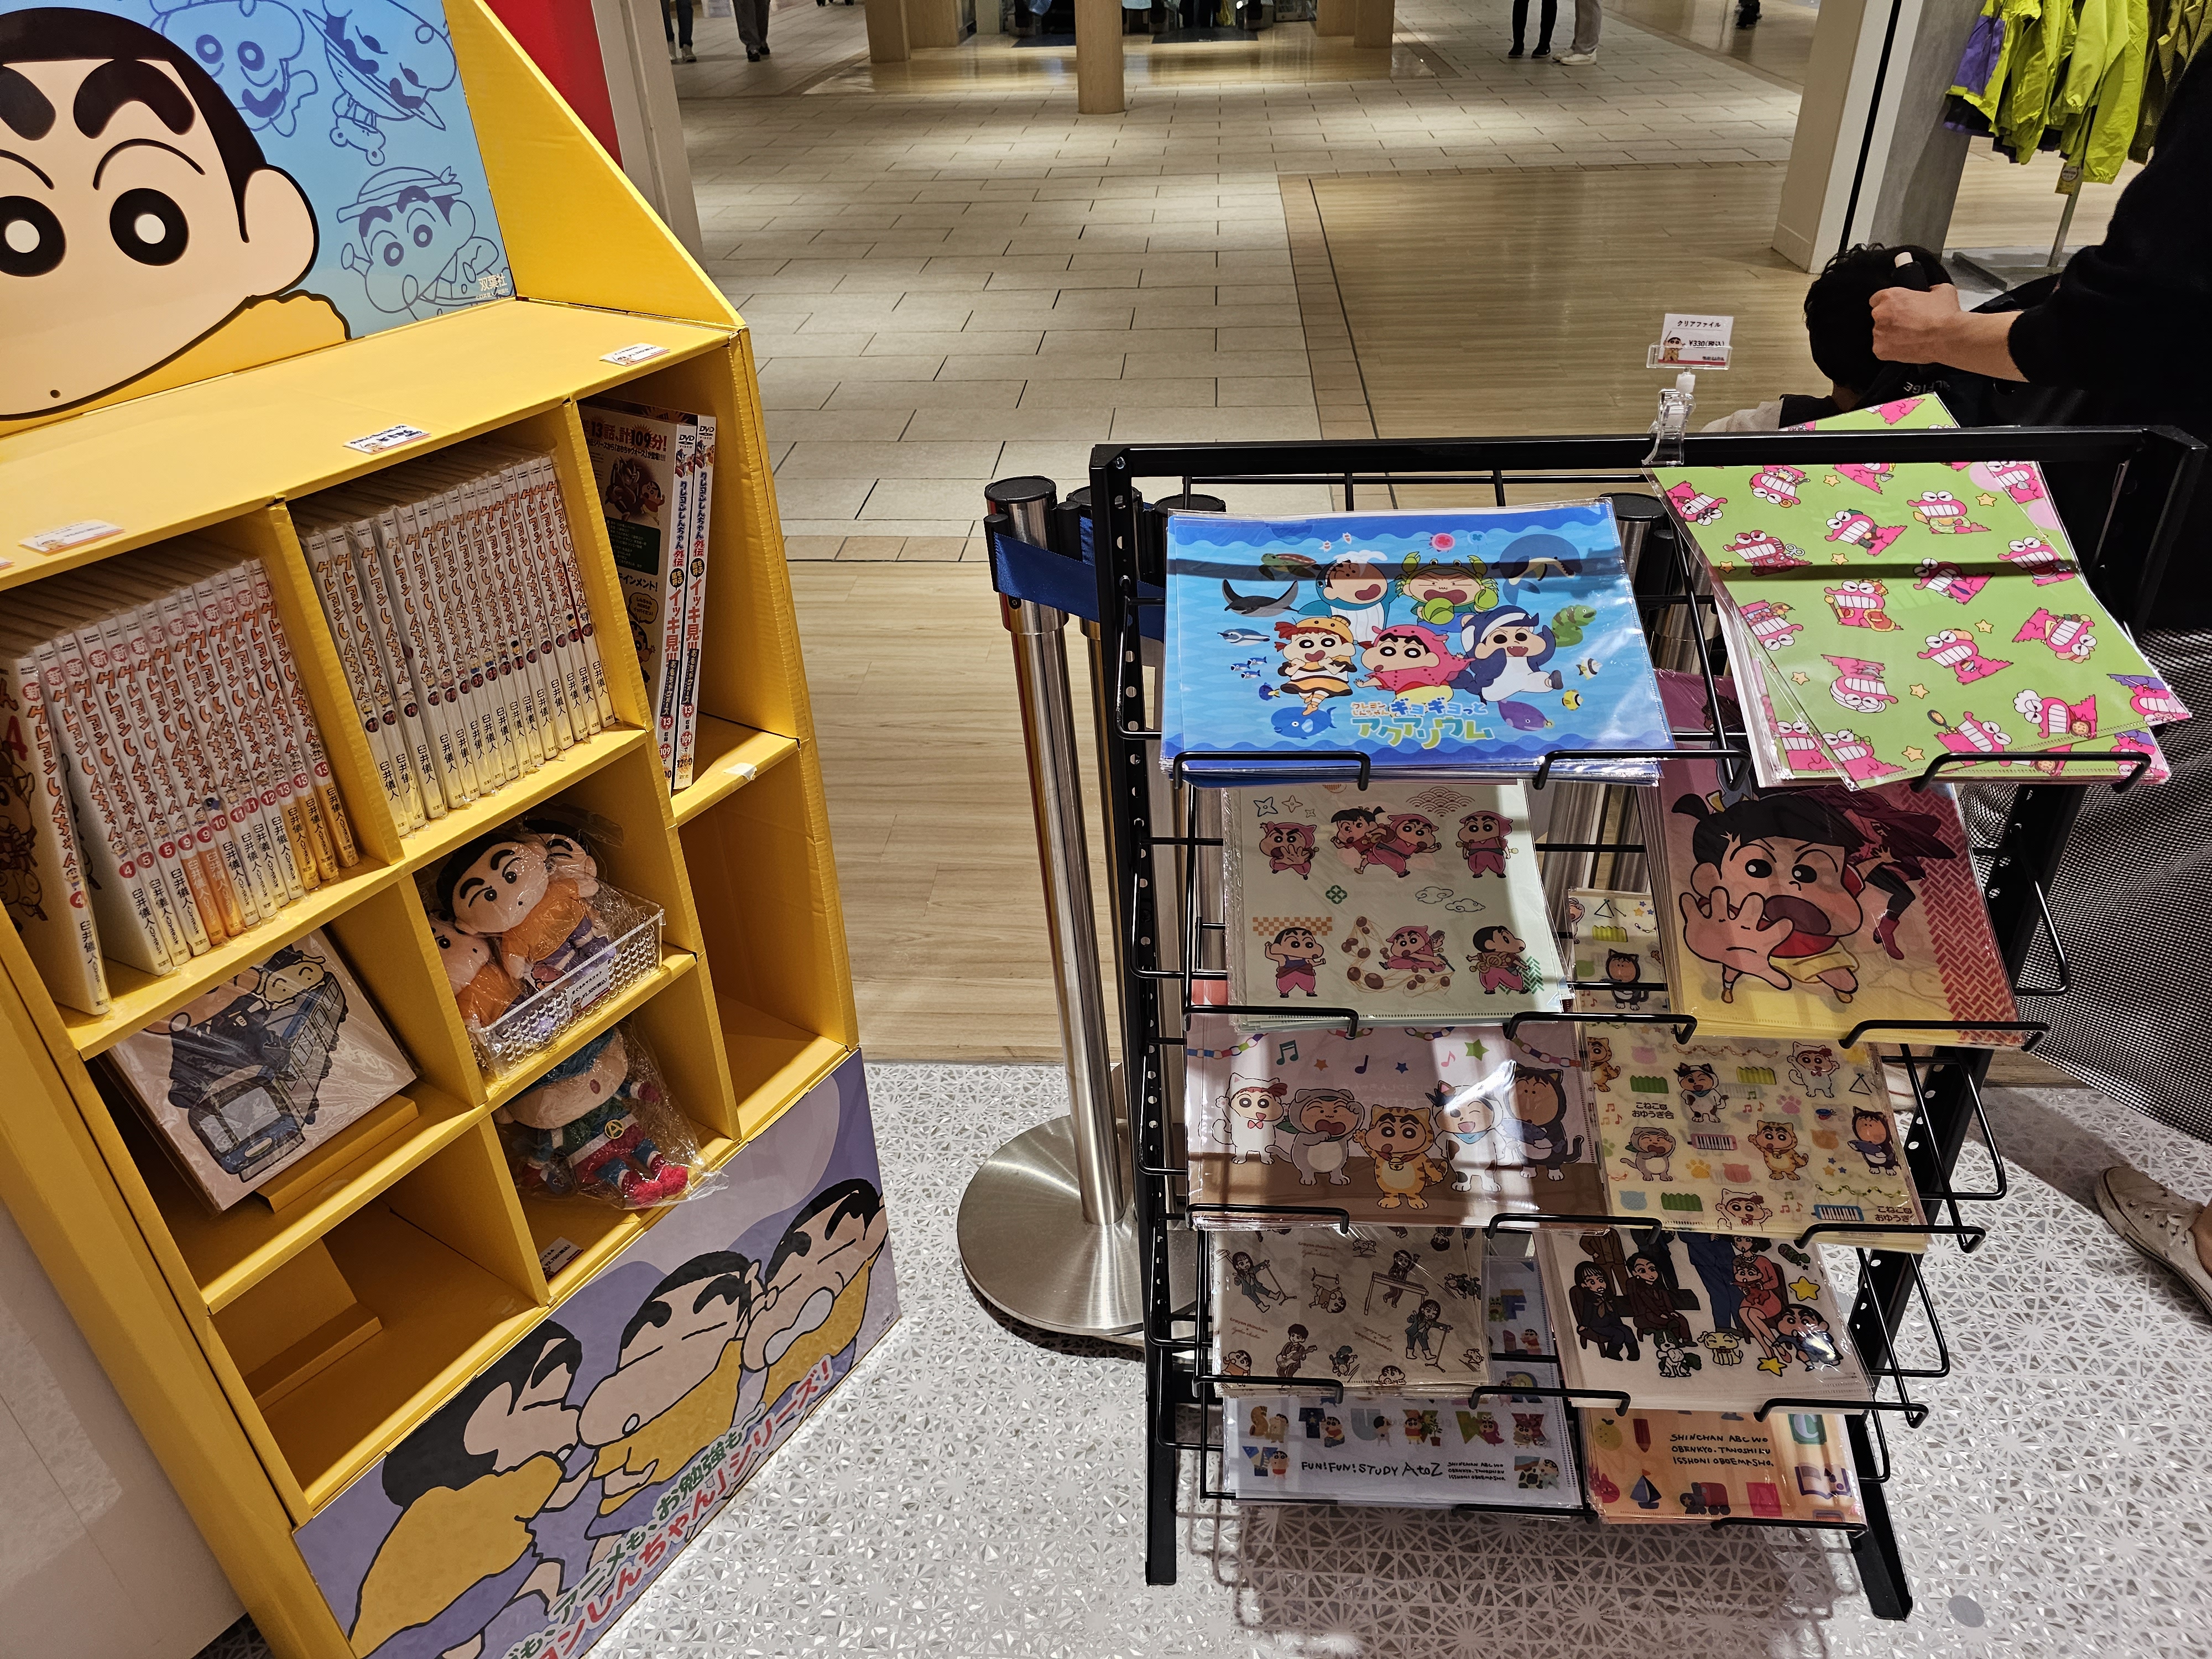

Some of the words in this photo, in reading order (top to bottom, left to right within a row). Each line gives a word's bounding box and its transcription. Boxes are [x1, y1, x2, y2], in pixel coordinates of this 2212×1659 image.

[478, 273, 507, 291] 双葉社
[673, 550, 685, 567] 外伝
[675, 481, 687, 549] クレヨンしんちゃん
[693, 539, 705, 556] 外伝
[695, 471, 707, 540] クレヨンしんちゃん
[91, 651, 107, 667] 新
[387, 537, 432, 674] クレヨンしんちゃん
[440, 734, 457, 774] 臼井儀人
[406, 533, 448, 669] クレヨンしんちゃん
[456, 728, 472, 768] 臼井儀人
[422, 526, 463, 660] クレヨンしんちゃん
[471, 721, 484, 759] 臼井儀人
[437, 520, 476, 655] クレヨンしんちゃん
[482, 714, 497, 752] 臼井儀人
[451, 514, 491, 648] クレヨンしんちゃん
[497, 707, 511, 745] 臼井儀人
[467, 510, 504, 643] クレヨンしんちゃん
[510, 701, 524, 739] 臼井儀人
[481, 505, 518, 637] クレヨンしんちゃん
[523, 696, 537, 734] 臼井儀人
[494, 501, 531, 630] クレヨンしんちゃん
[537, 688, 551, 727] 臼井儀人
[507, 493, 545, 623] クレヨンしんちゃん
[551, 679, 566, 717] 臼井儀人
[520, 487, 560, 617] クレヨンしんちゃん
[566, 672, 581, 709] 臼井儀人
[533, 484, 572, 611] クレヨンしんちゃん
[579, 666, 593, 704] 臼井儀人
[546, 480, 586, 606] クレヨンしんちゃん
[592, 661, 608, 697] 臼井儀人
[25, 684, 41, 701] 新
[46, 668, 63, 685] 新
[67, 660, 84, 676] 新
[118, 664, 182, 815] クレヨンしんちゃん
[139, 658, 201, 807] クレヨンしんちゃん
[154, 646, 216, 795] クレヨンしんちゃん
[175, 638, 234, 787] クレヨンしんちゃん
[190, 630, 248, 776] クレヨンしんちゃん
[210, 624, 266, 770] クレヨンしんちゃん
[227, 617, 281, 762] クレヨンしんちゃん
[243, 609, 298, 753] クレヨンしんちゃん
[262, 602, 318, 743] クレヨンしんちゃん
[316, 560, 369, 700] クレヨンしんちゃん
[380, 761, 399, 801] 臼井儀人
[336, 553, 387, 693] クレヨンしんちゃん
[396, 754, 415, 794] 臼井儀人
[361, 546, 409, 684] クレヨンしんちゃん
[417, 744, 435, 784] 臼井儀人
[1351, 717, 1495, 749] アクアリウム
[1391, 697, 1488, 716] ギョギョっと
[28, 705, 77, 867] クレヨンしんちゃん
[54, 687, 123, 842] クレヨンしんちゃん
[74, 679, 142, 832] クレヨンしんちゃん
[97, 670, 164, 822] クレヨンしんちゃん
[1632, 1110, 1674, 1119] おゆうぎ会
[1875, 1213, 1915, 1223] おゆうぎ
[1359, 1463, 1398, 1476] STUDY
[1670, 1433, 1724, 1442] SHINCHAN
[1673, 1456, 1710, 1464] ISSHONI
[1713, 1458, 1775, 1467] OBOEMASHO.
